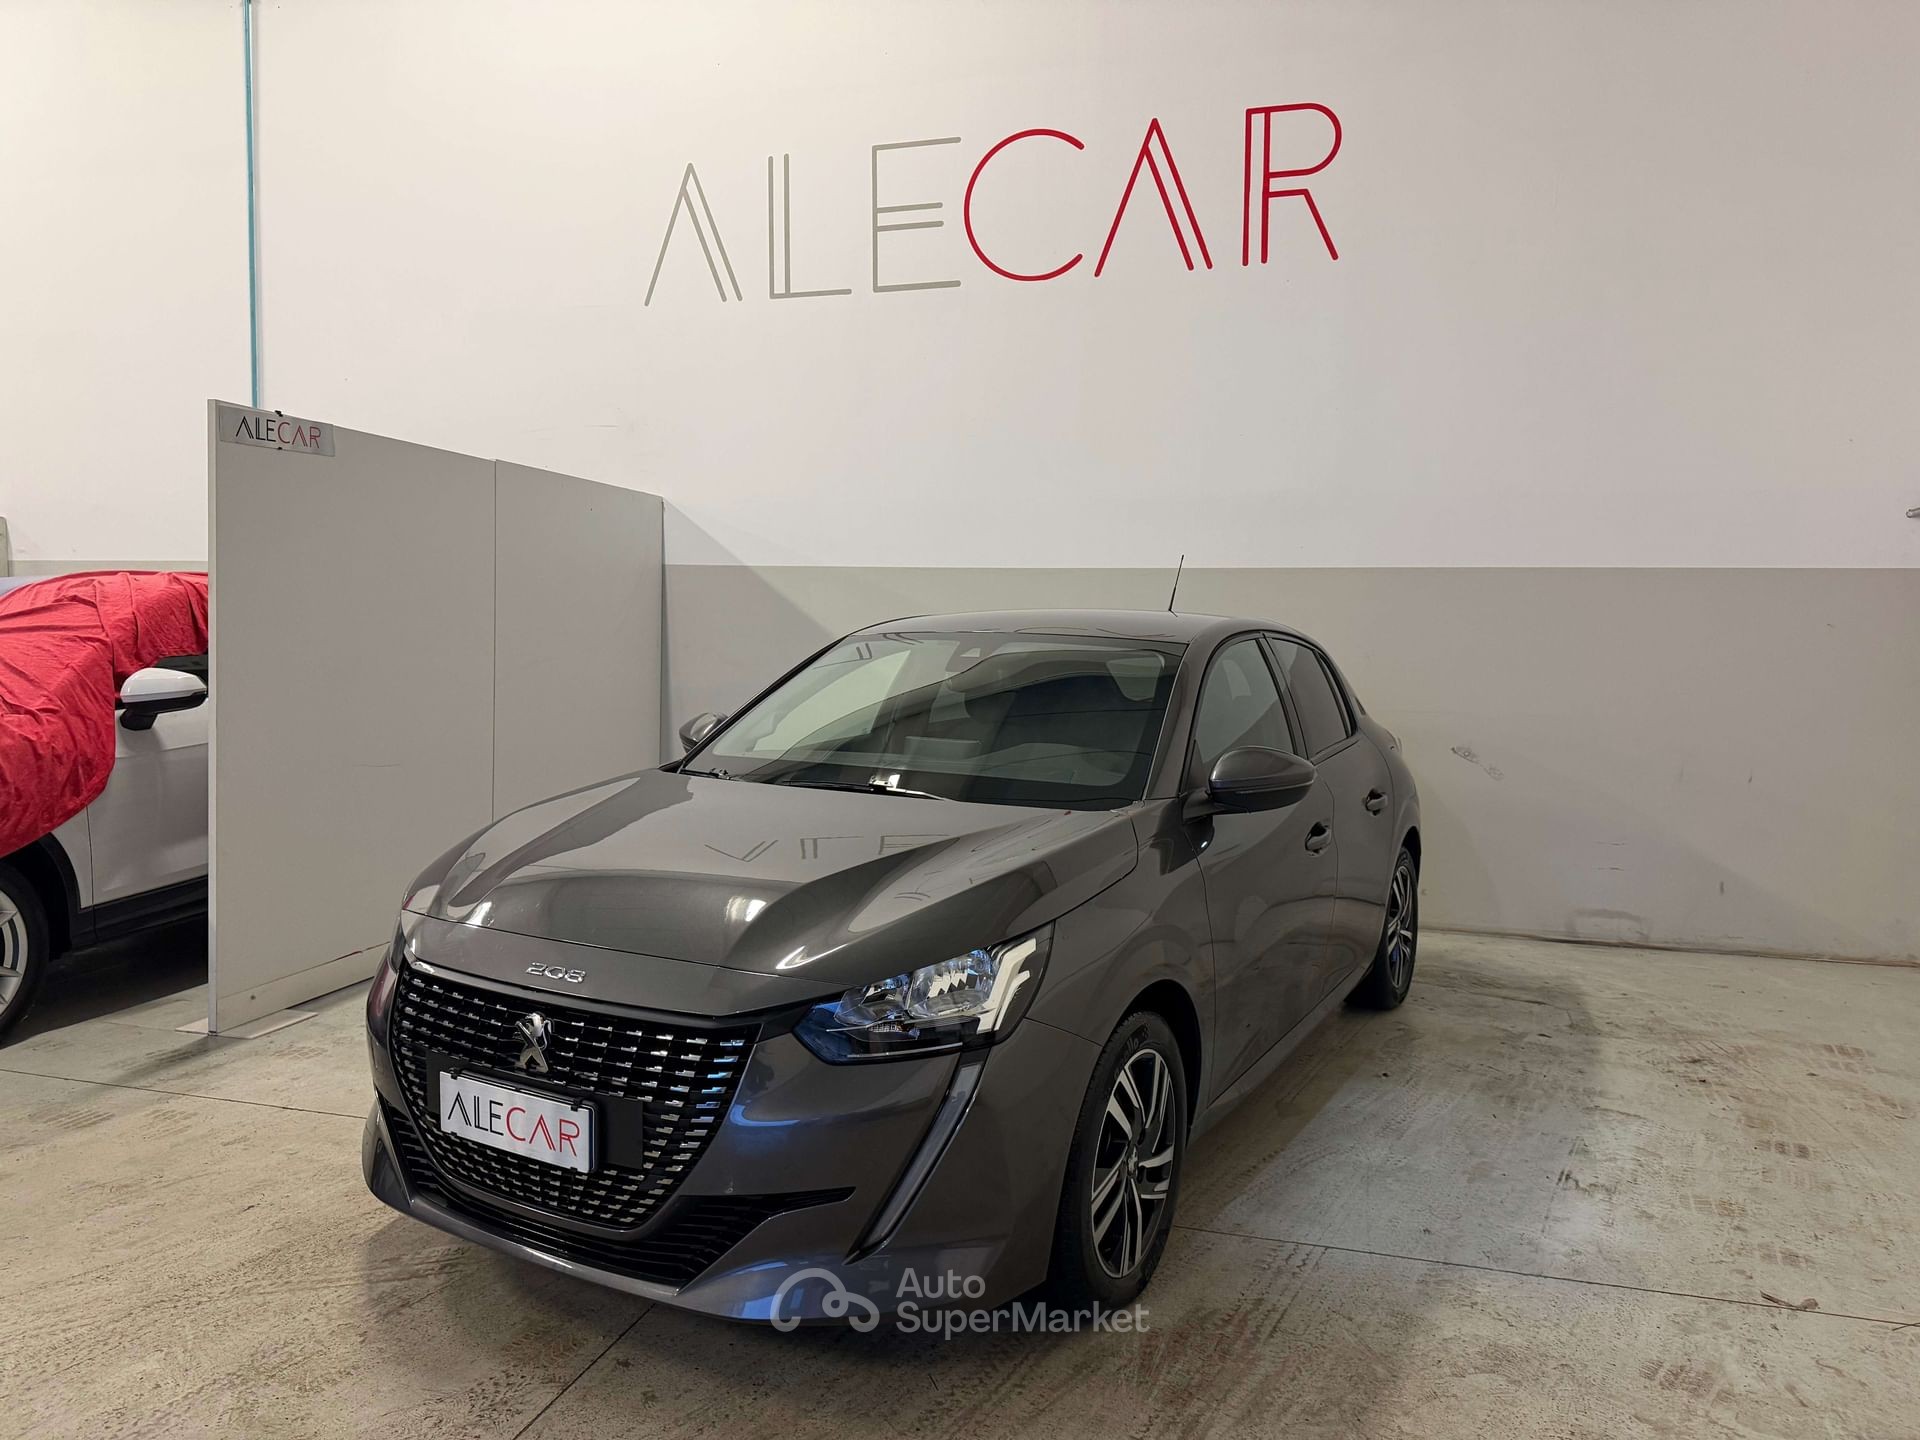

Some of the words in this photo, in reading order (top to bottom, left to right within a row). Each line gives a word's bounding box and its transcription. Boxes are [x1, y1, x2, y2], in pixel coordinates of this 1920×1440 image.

[645, 102, 1342, 306] ALECAR
[235, 415, 322, 449] ALECAR
[526, 962, 586, 983] 208
[447, 1091, 580, 1156] ALECAR
